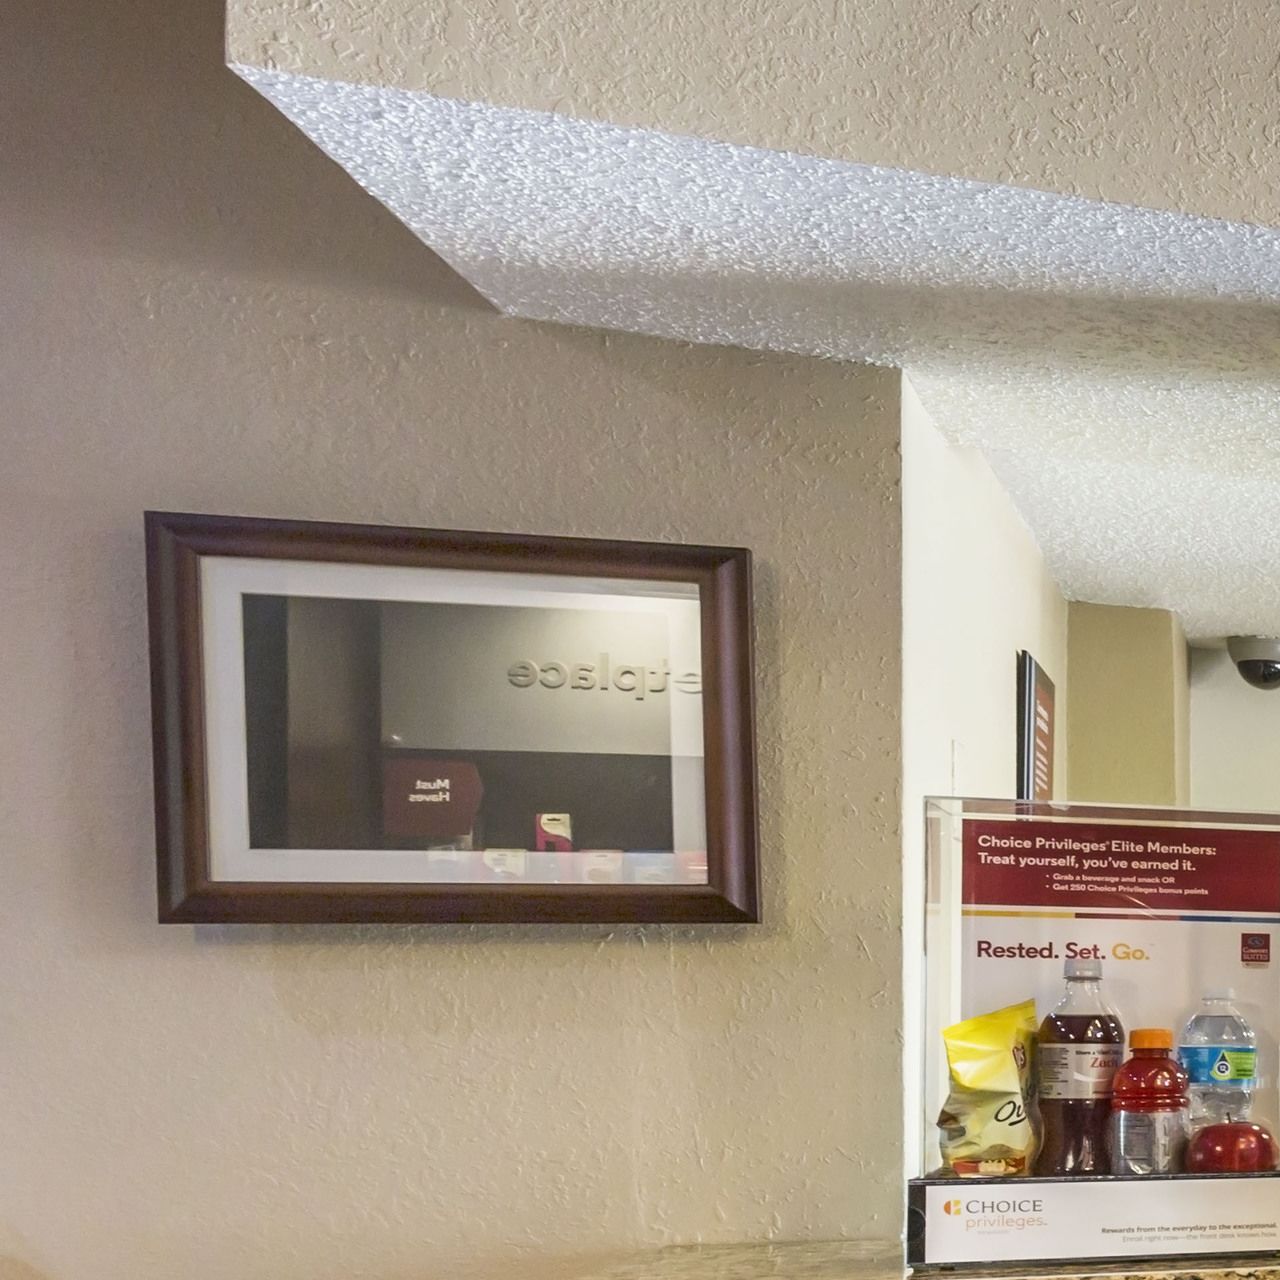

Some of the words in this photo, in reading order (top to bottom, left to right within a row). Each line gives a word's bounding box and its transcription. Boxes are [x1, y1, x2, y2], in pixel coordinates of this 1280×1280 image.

[978, 835, 1032, 848] Choice
[1111, 840, 1144, 853] Elite
[1147, 842, 1217, 856] Members:
[978, 852, 1016, 866] Treat
[1019, 854, 1079, 868] yourself,
[1082, 857, 1129, 870] you've
[1131, 860, 1179, 871] earned
[1182, 860, 1196, 871] it.
[1053, 873, 1075, 881] Grab
[1082, 875, 1119, 884] beverage
[1053, 883, 1069, 891] Get
[1070, 884, 1086, 892] 250
[1087, 884, 1117, 893] Choice
[1118, 885, 1157, 895] Privileges
[1159, 887, 1182, 895] bonus
[1184, 888, 1209, 896] points
[977, 940, 1059, 960] Rested.
[1065, 942, 1106, 960] Set.
[1111, 943, 1150, 961] Go.
[966, 1199, 1043, 1214] CHOICE
[1136, 1226, 1156, 1234] from
[1172, 1225, 1207, 1234] everyday
